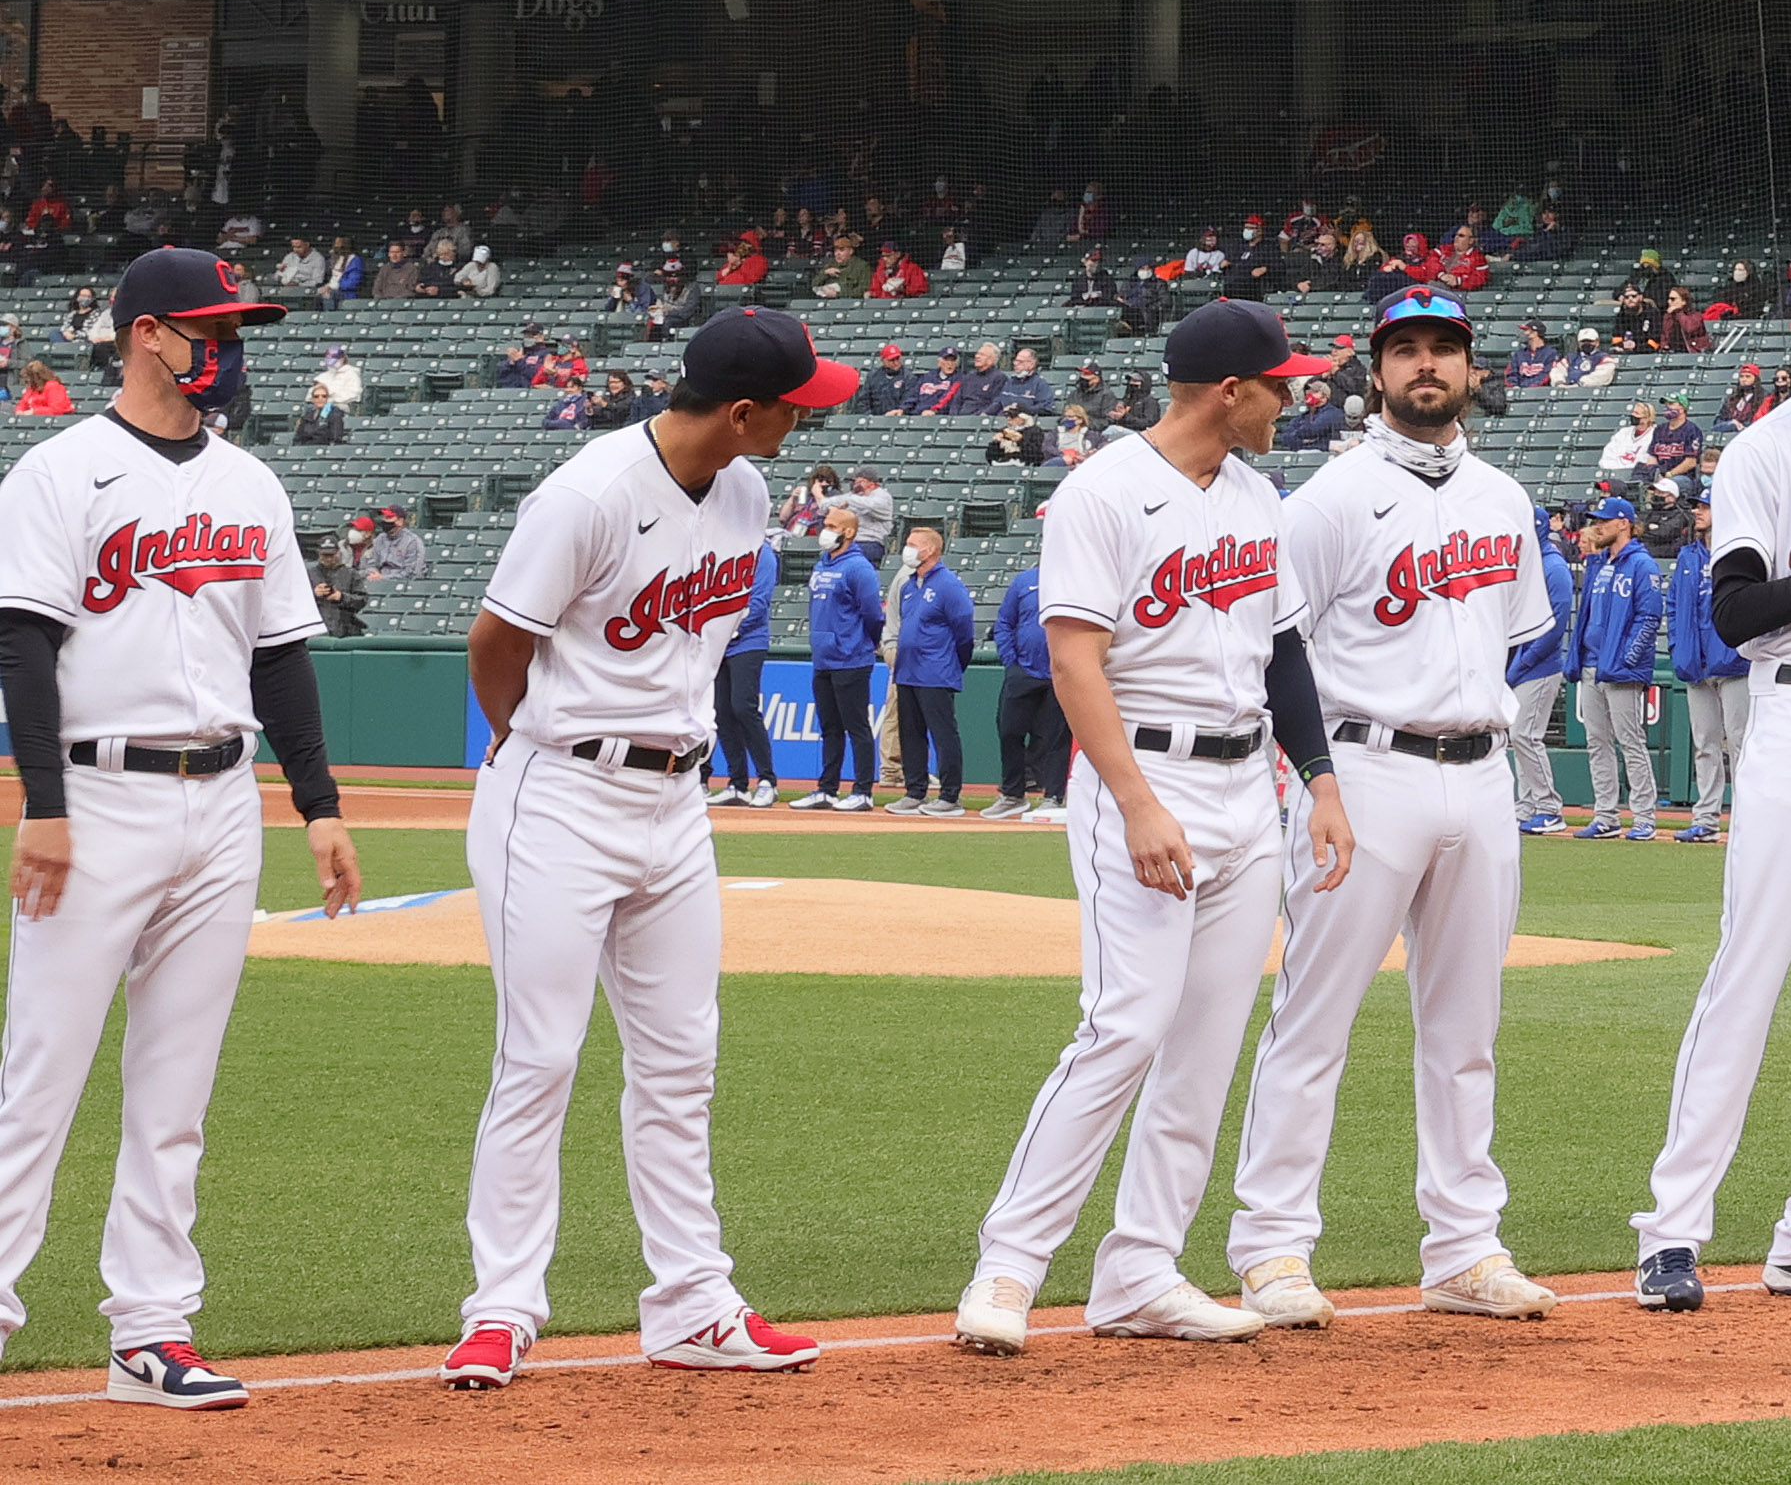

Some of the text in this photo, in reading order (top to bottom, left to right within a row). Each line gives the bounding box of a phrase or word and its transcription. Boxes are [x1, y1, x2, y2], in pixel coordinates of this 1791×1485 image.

[215, 260, 239, 294] C
[82, 512, 268, 615] Indian
[603, 549, 761, 653] Indian
[1132, 533, 1278, 630] Indian
[1611, 572, 1633, 598] KC
